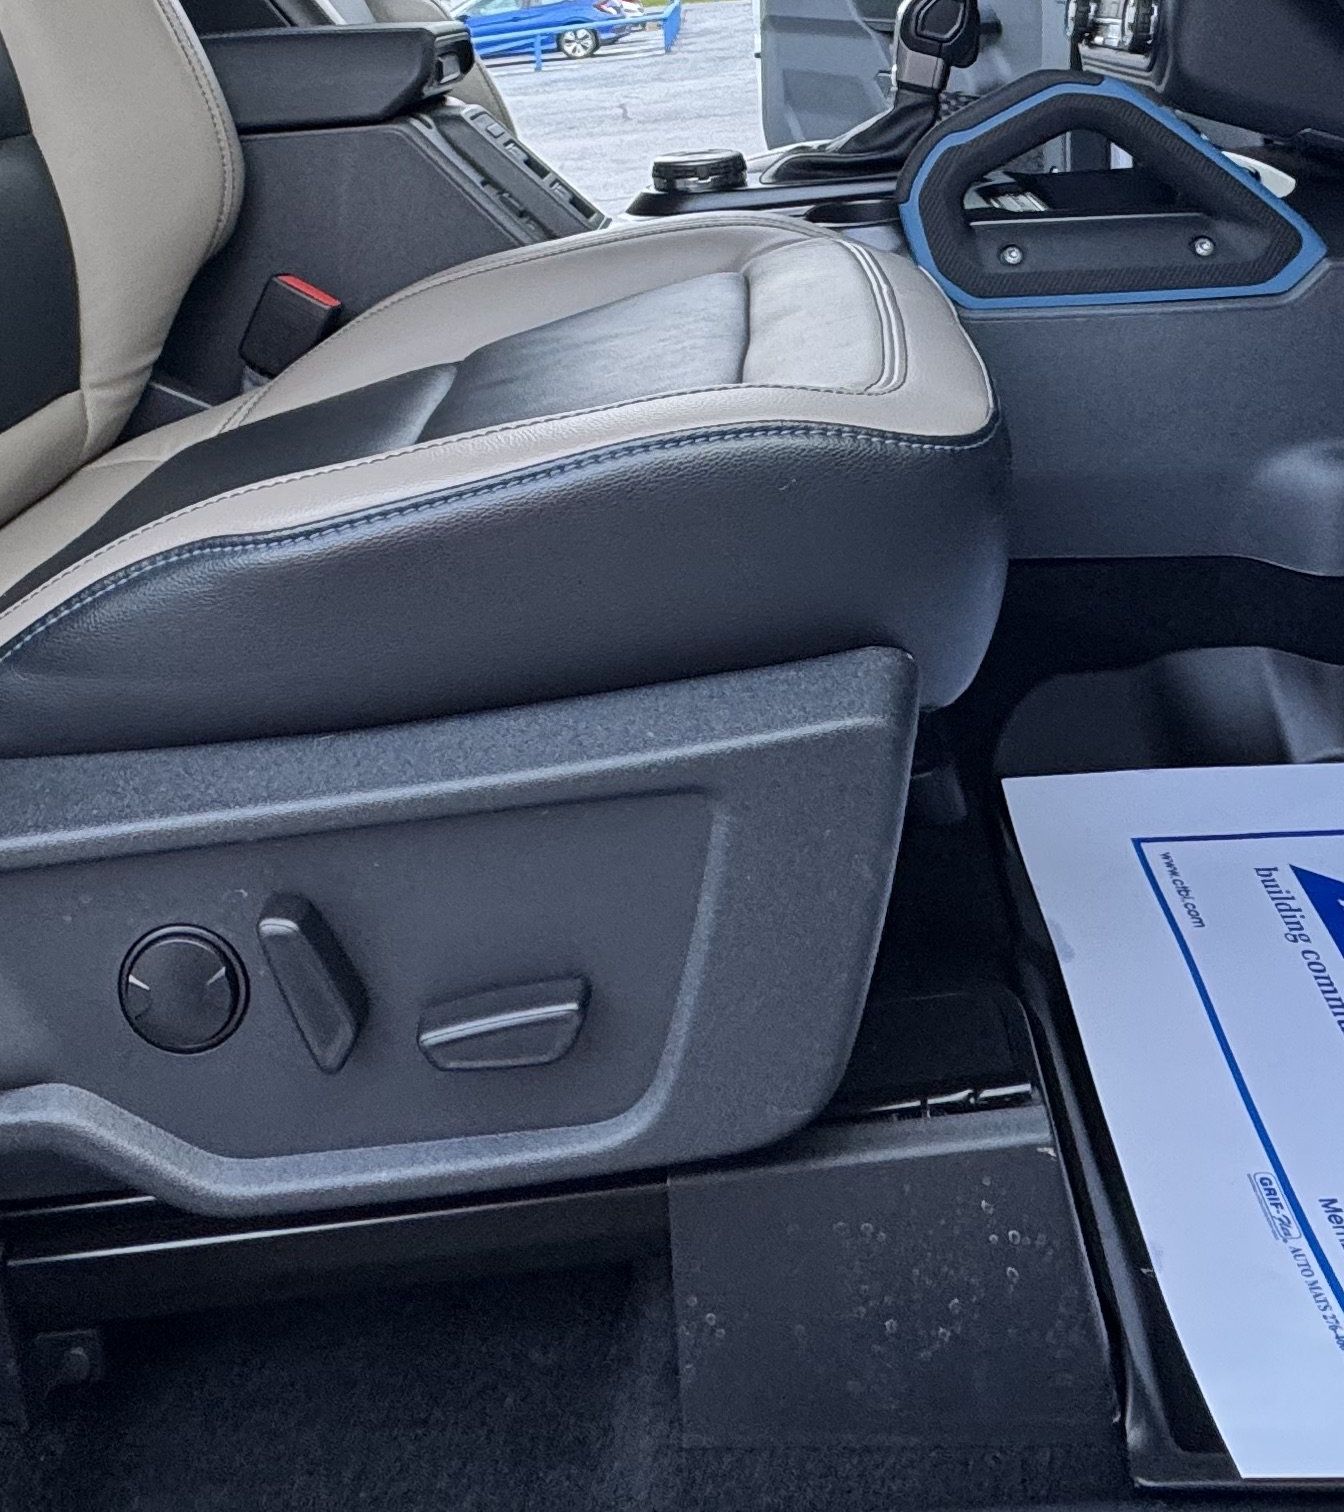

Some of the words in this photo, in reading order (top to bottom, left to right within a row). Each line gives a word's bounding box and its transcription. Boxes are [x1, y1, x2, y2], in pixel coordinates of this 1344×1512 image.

[1254, 867, 1311, 943] building
[1290, 1246, 1316, 1279] AUTO
[1305, 1280, 1332, 1313] MATS
